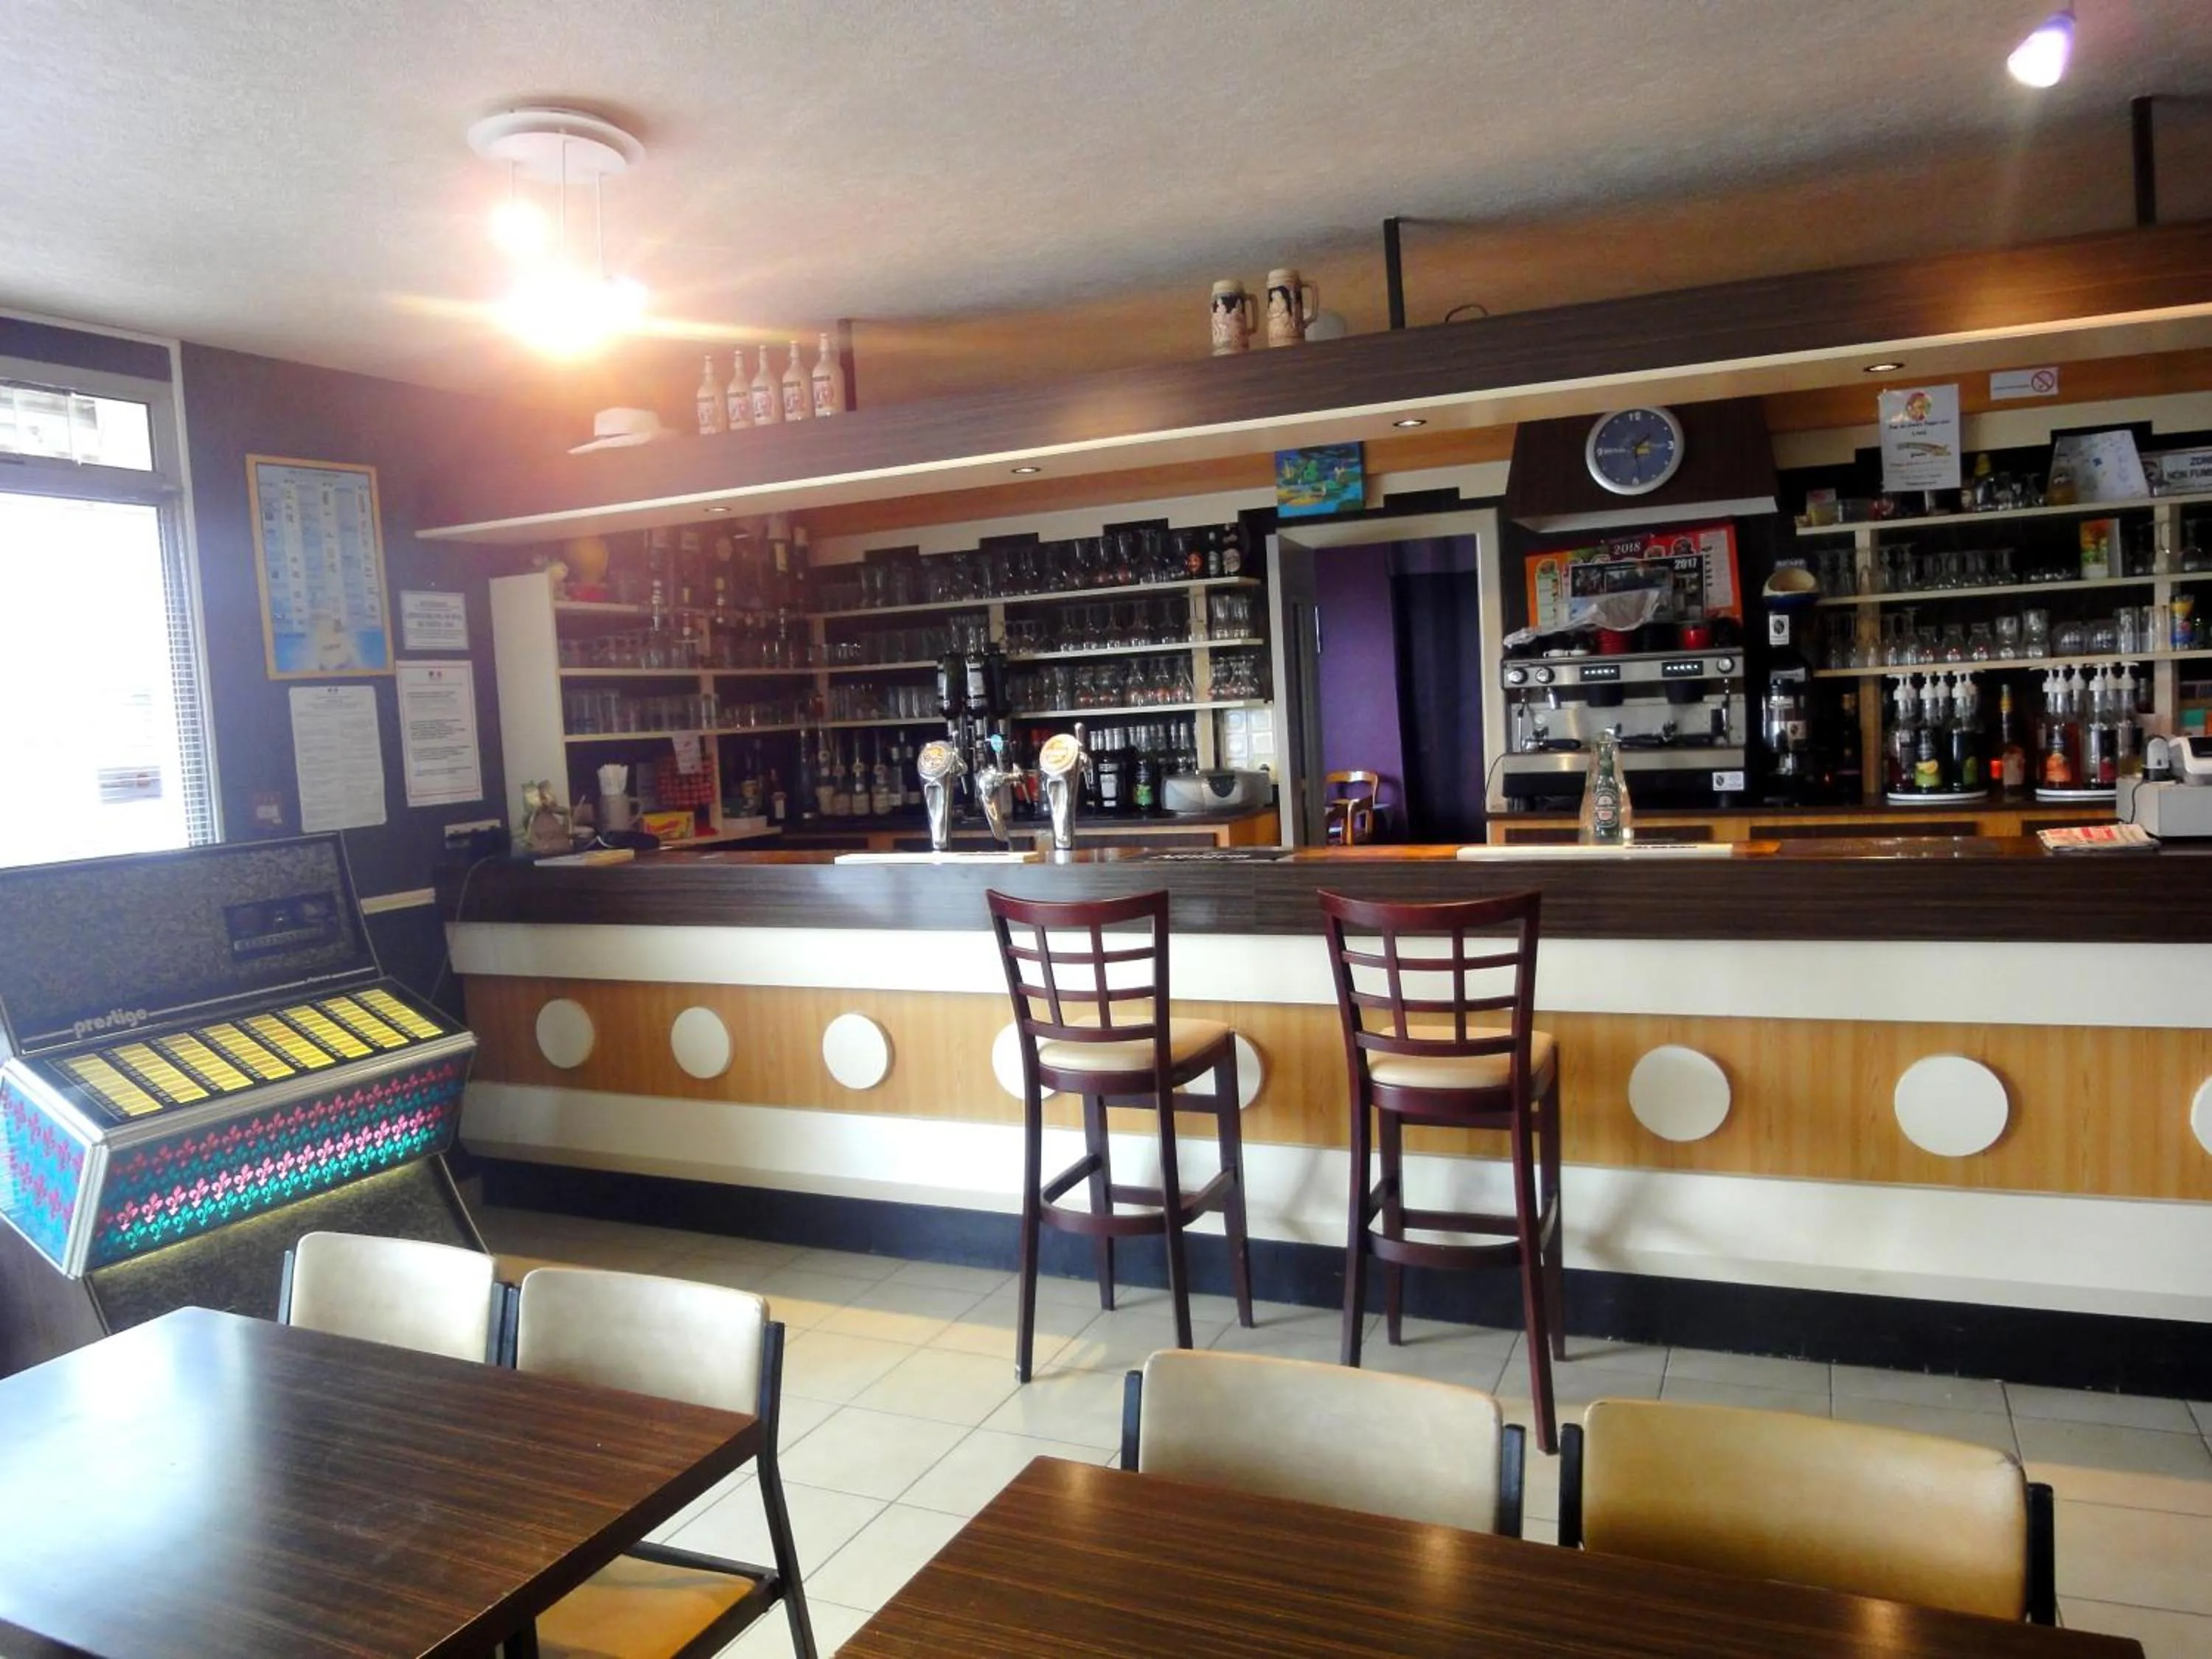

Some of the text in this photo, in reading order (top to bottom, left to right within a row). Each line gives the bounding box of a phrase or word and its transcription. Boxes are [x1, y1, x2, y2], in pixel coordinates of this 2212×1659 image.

[1629, 411, 1641, 421] 12
[1667, 440, 1674, 450] 3
[1596, 448, 1604, 457] 9
[1614, 542, 1641, 555] 2018
[1674, 557, 1697, 571] 2017
[74, 1008, 147, 1040] prestige
